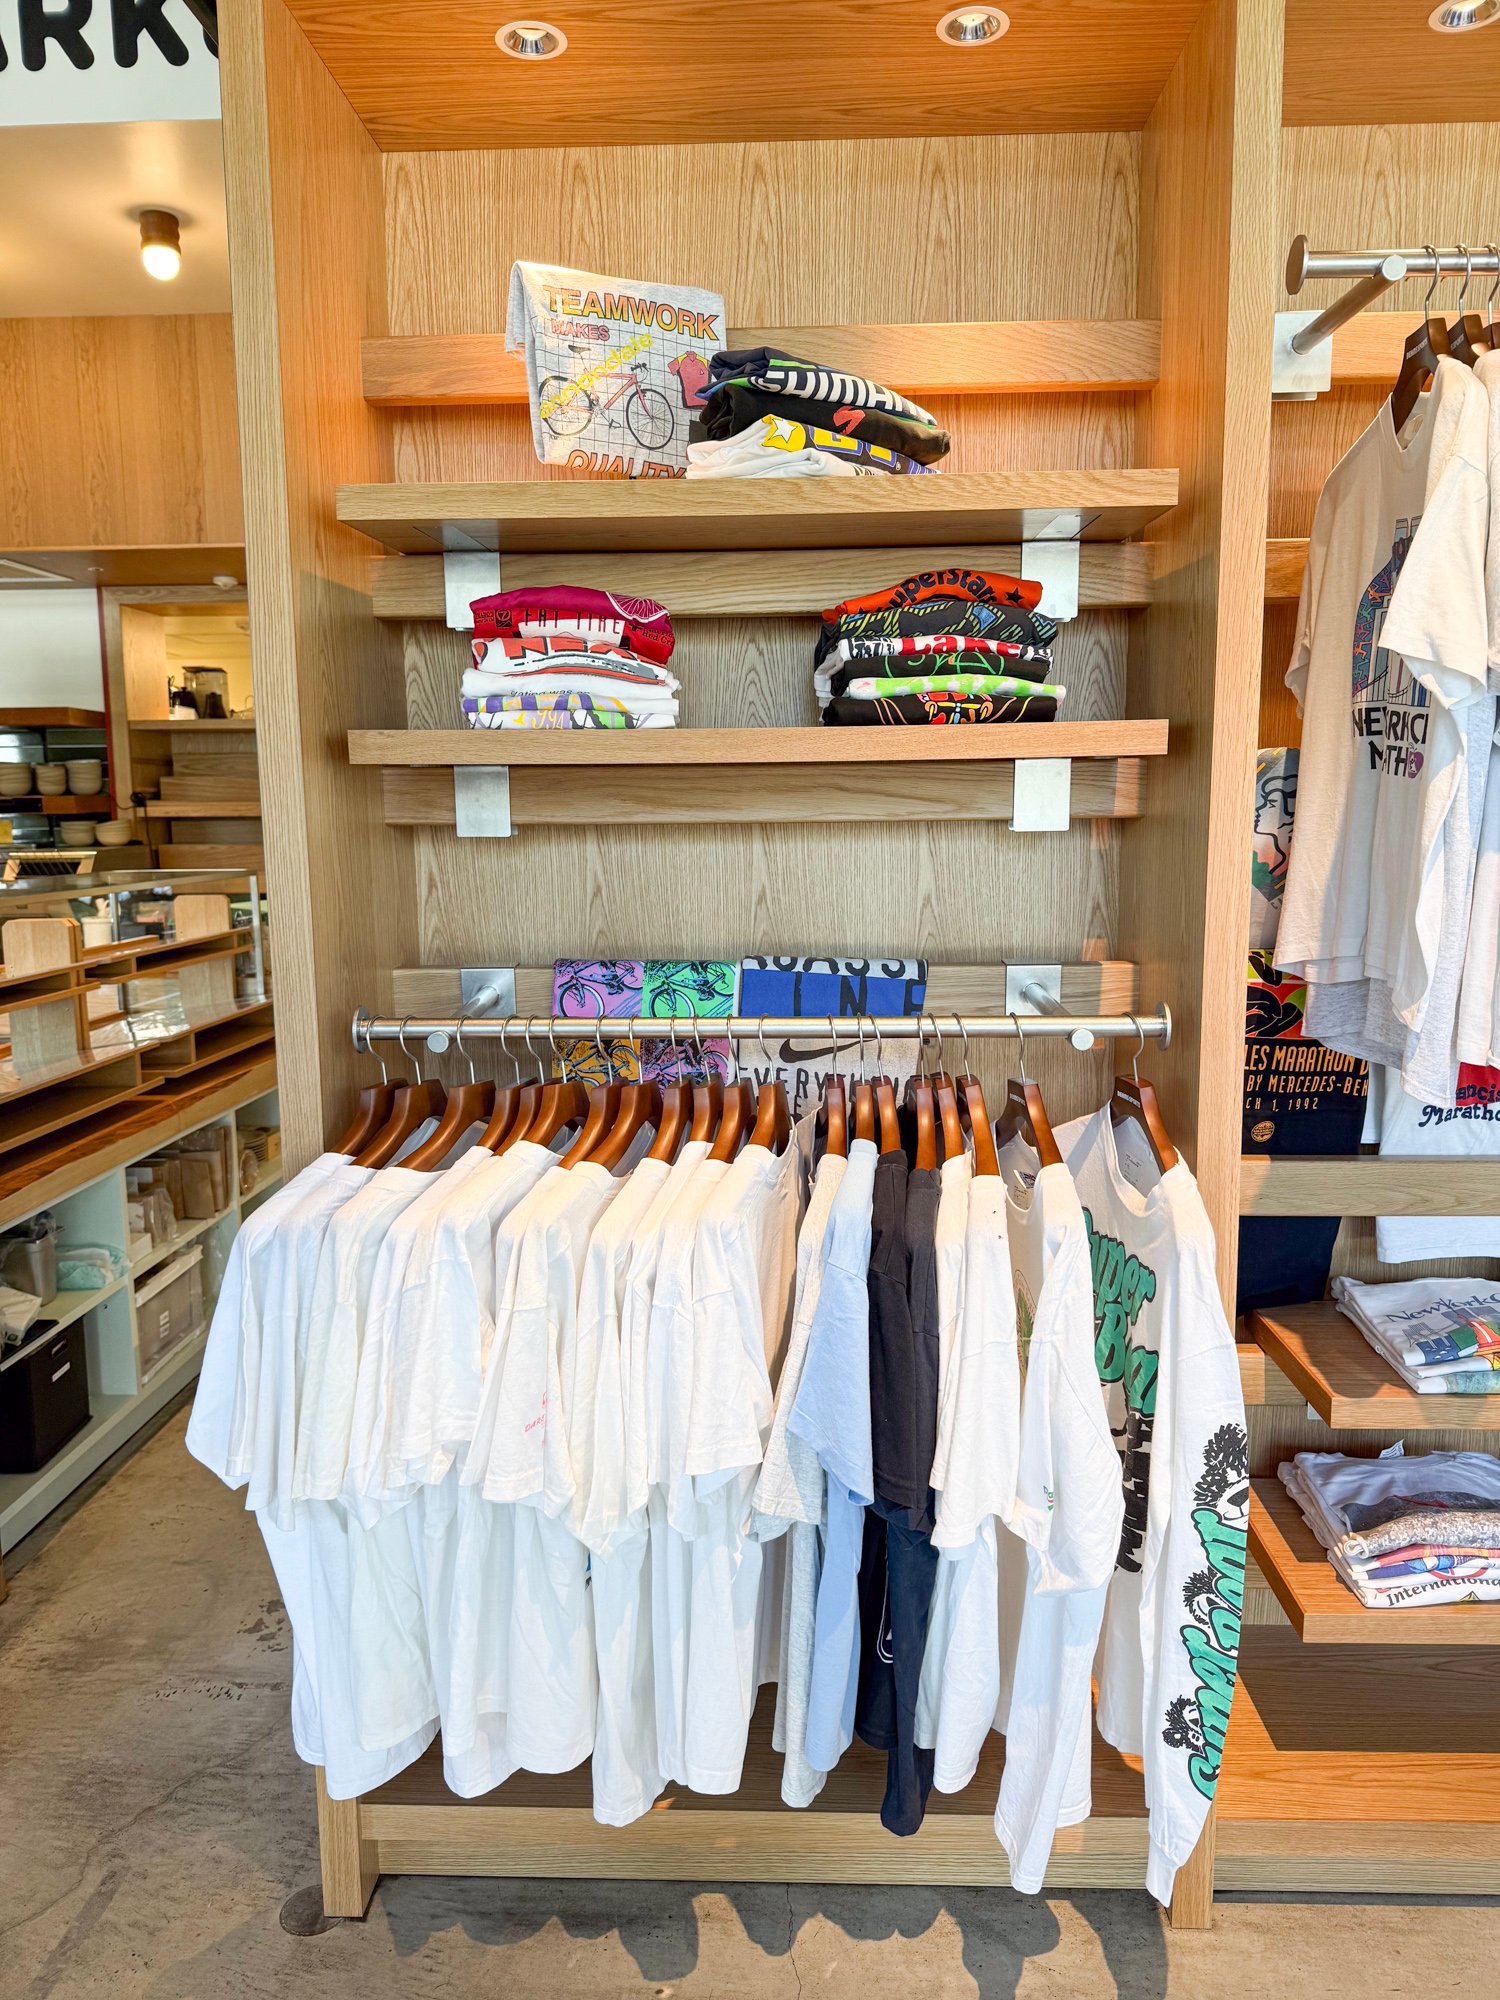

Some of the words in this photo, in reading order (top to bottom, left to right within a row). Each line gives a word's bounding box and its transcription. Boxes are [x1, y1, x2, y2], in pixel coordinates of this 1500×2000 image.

[0, 0, 219, 72] RK
[543, 284, 719, 341] TEAMWORK
[551, 319, 610, 341] MAKES
[878, 568, 997, 610] uperstar
[1271, 1046, 1355, 1073] MARATHON
[1247, 1074, 1263, 1092] BY
[1288, 1097, 1319, 1111] 1992
[1083, 1206, 1157, 1326] uper
[1385, 1300, 1441, 1322] New
[1437, 1295, 1488, 1311] York
